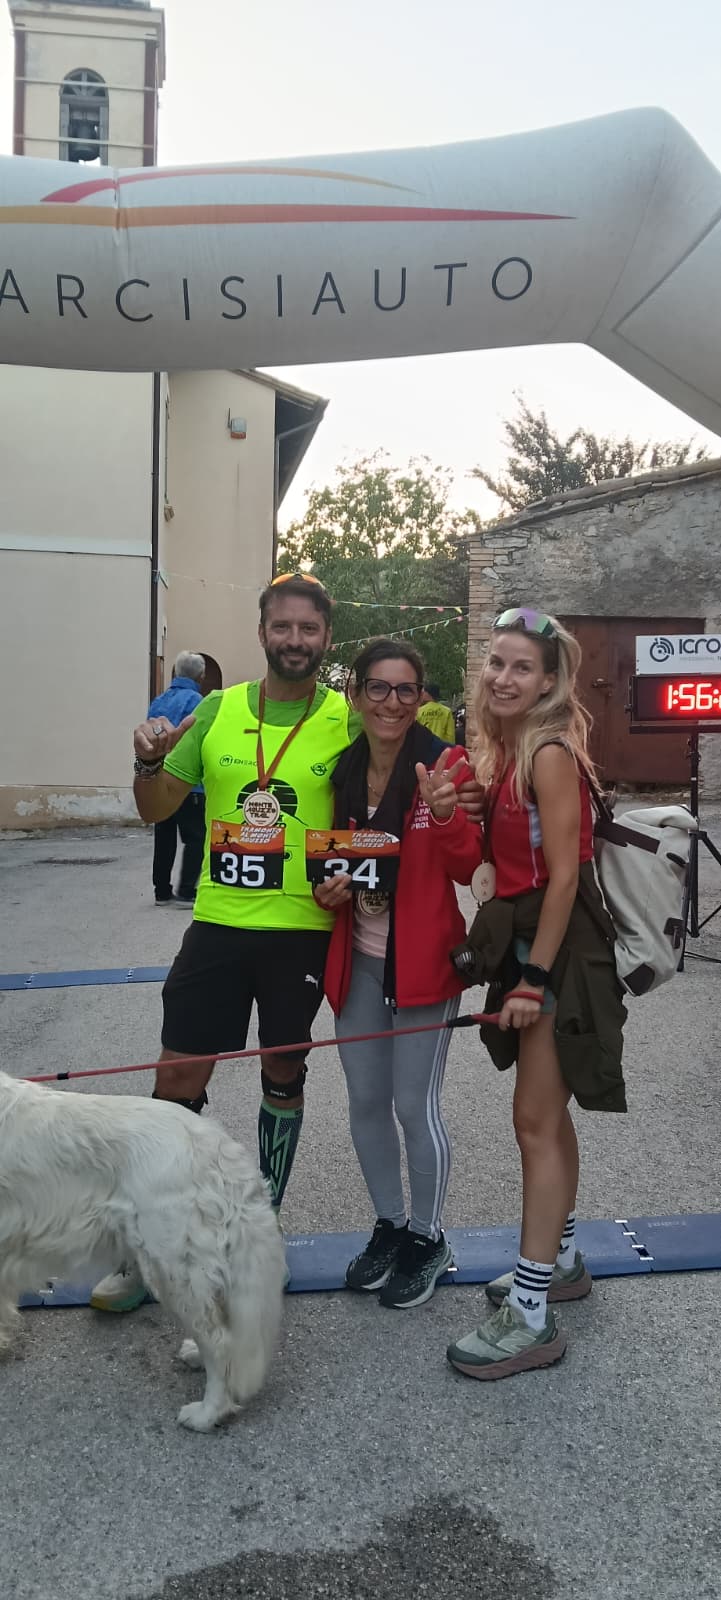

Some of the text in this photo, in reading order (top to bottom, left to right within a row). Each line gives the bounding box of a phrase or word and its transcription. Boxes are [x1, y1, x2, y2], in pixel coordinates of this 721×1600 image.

[0, 256, 534, 323] ARCISIAUTO
[667, 683, 721, 710] 1:56:
[219, 851, 265, 887] 35
[323, 858, 380, 889] 34
